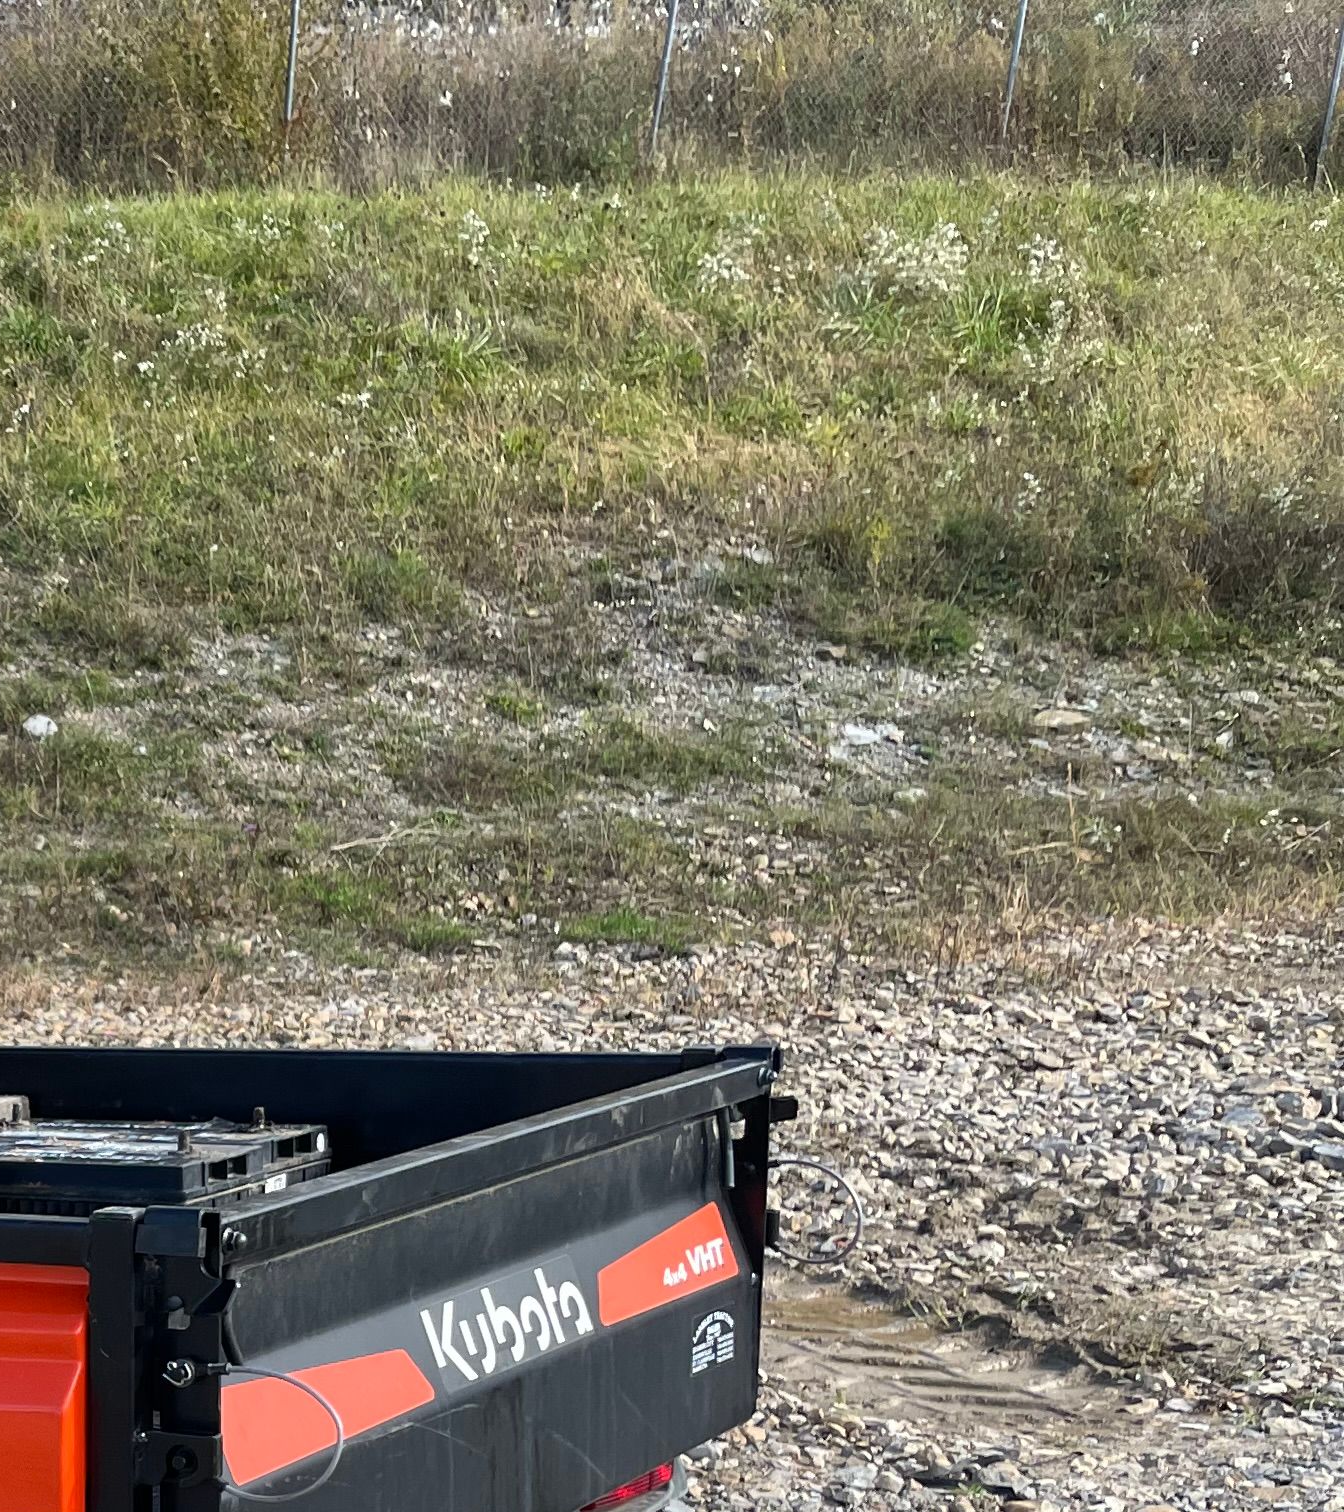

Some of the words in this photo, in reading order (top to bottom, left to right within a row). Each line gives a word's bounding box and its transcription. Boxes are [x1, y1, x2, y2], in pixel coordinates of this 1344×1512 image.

[663, 1262, 687, 1286] 4x4
[685, 1237, 724, 1275] VHT
[420, 1267, 594, 1381] Kubota
